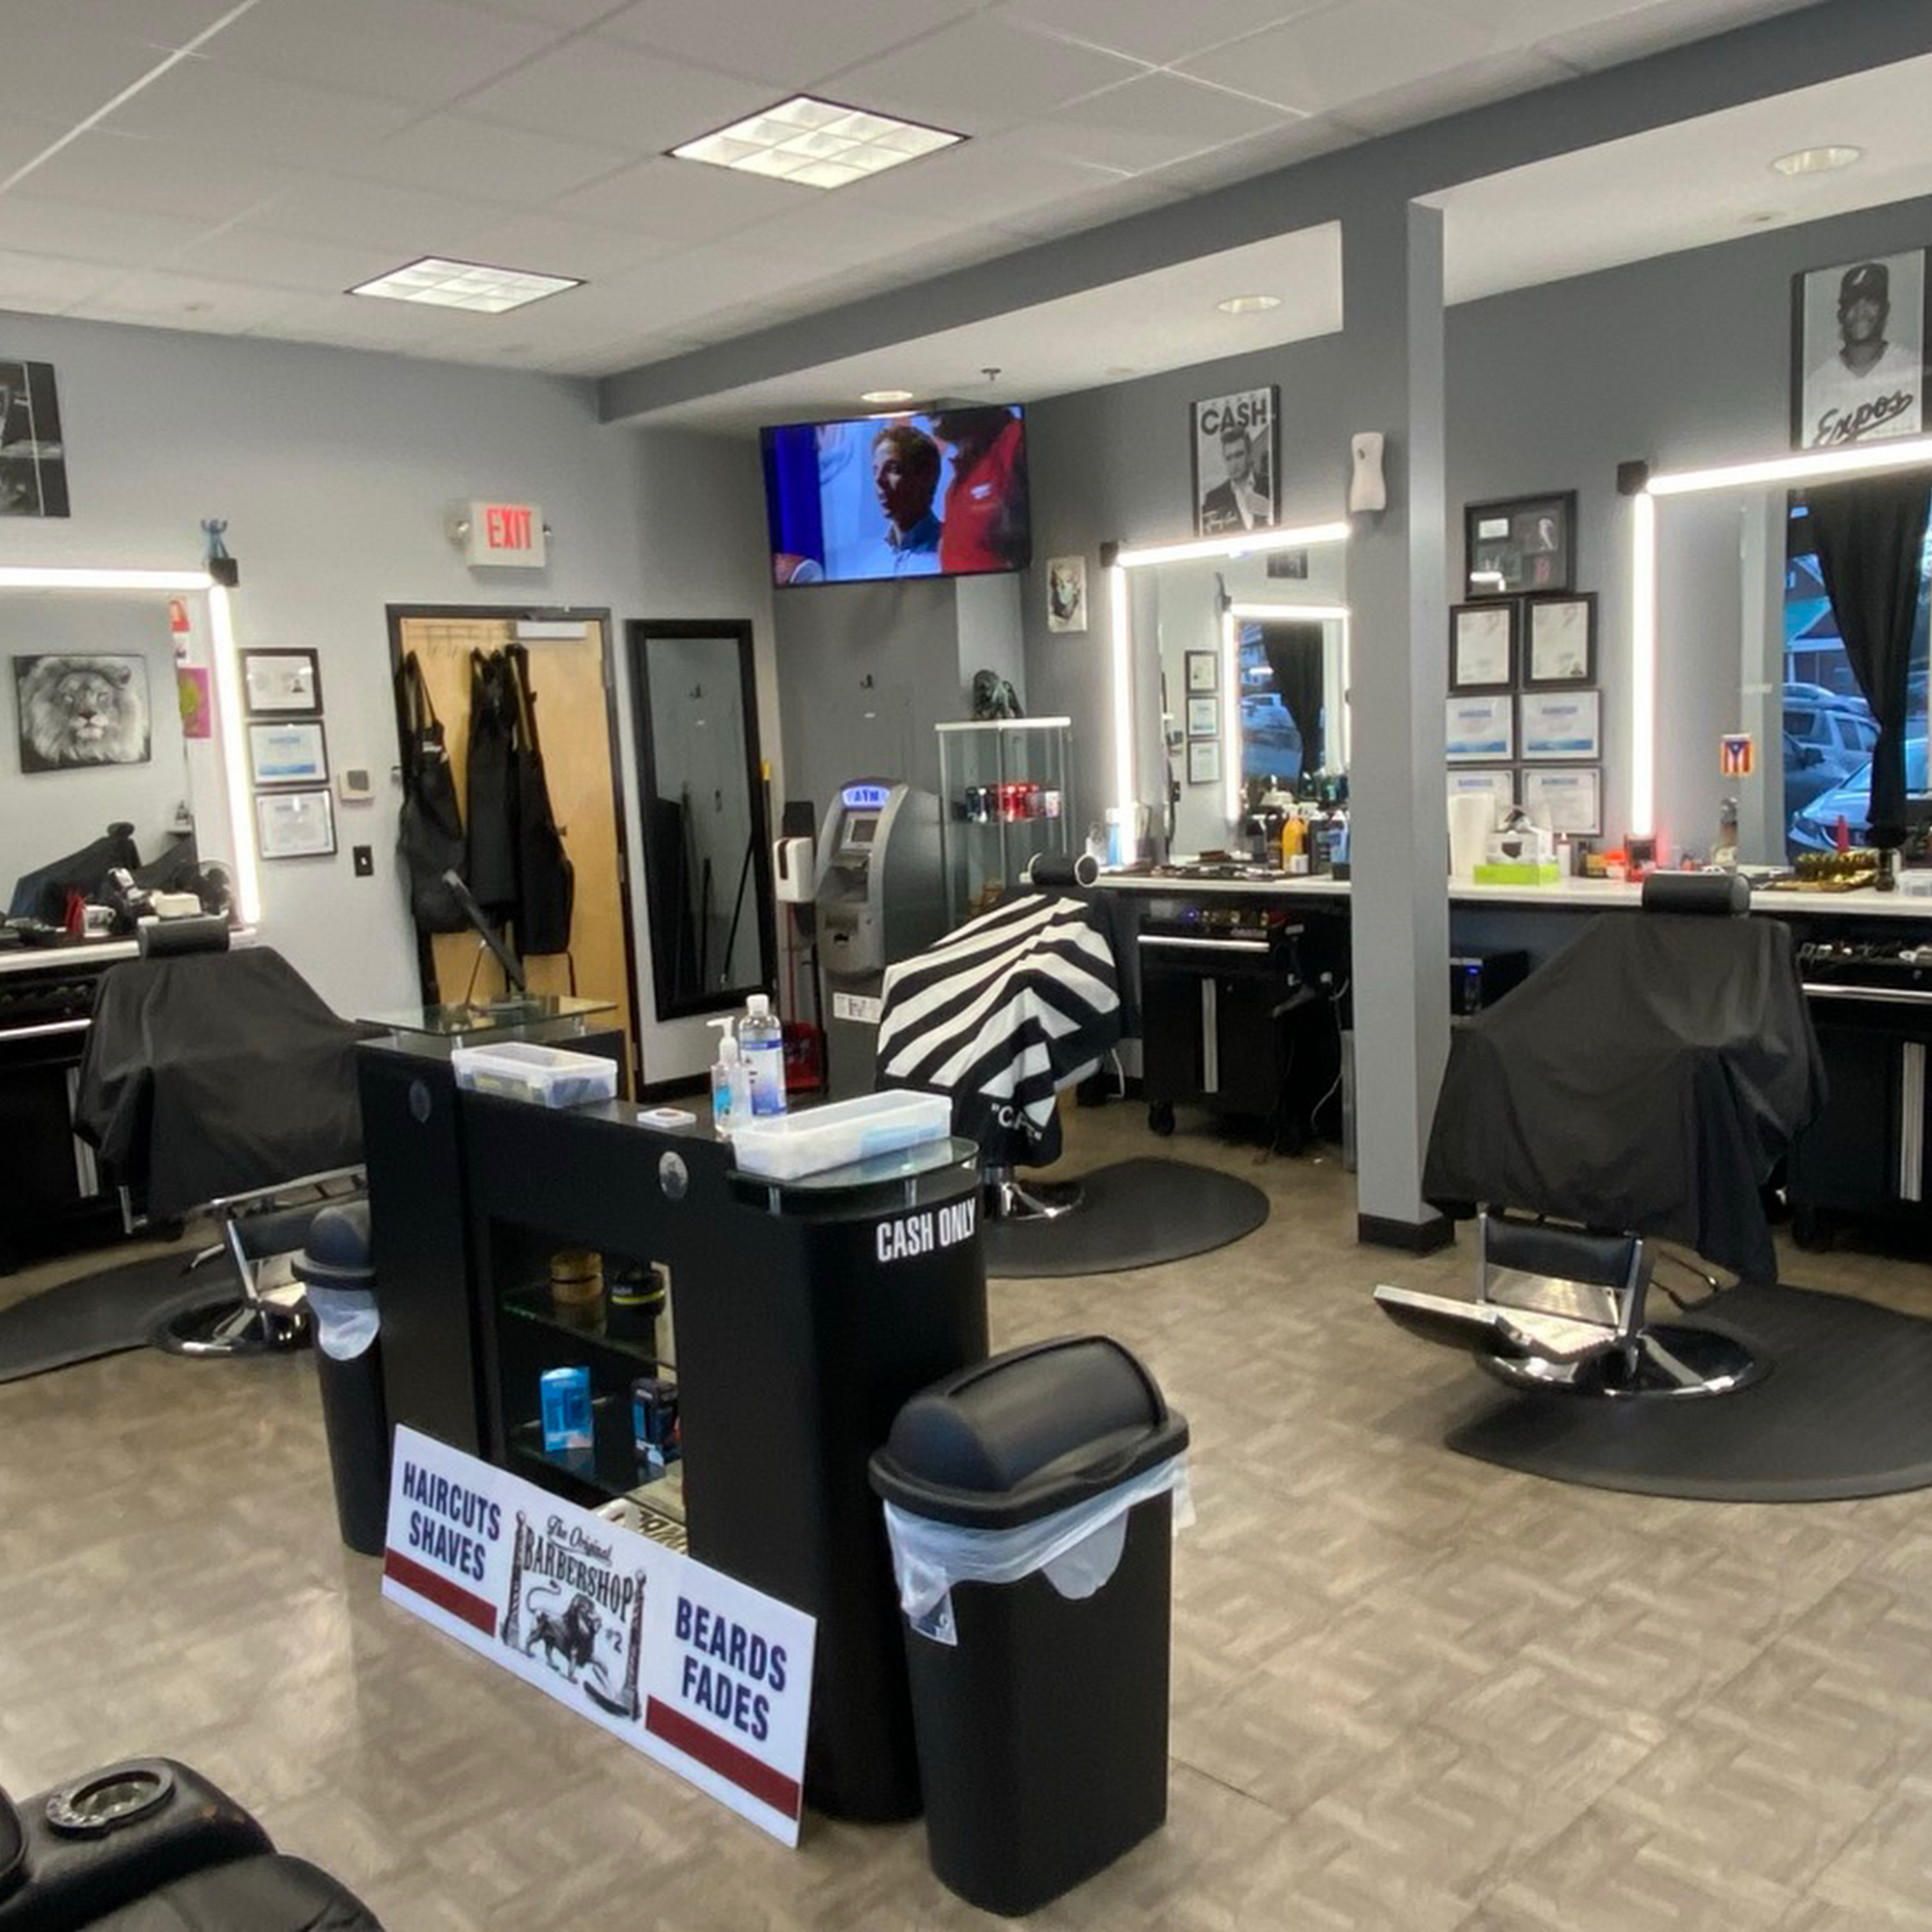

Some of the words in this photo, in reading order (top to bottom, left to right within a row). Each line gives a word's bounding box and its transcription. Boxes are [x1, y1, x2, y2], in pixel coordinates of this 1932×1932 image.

[1201, 398, 1268, 436] CASH
[1814, 389, 1914, 445] Expos
[487, 506, 532, 550] EXIT
[854, 788, 880, 803] ATM
[876, 1211, 934, 1263] CASH
[938, 1197, 976, 1247] ONLY
[403, 1461, 501, 1541] HAIRCUTS
[409, 1510, 486, 1581] SHAVES
[547, 1514, 568, 1540] The
[569, 1526, 613, 1560] Original
[523, 1524, 634, 1624] BARBERSHOP
[675, 1595, 787, 1692] BEARDS
[682, 1655, 770, 1742] FADES
